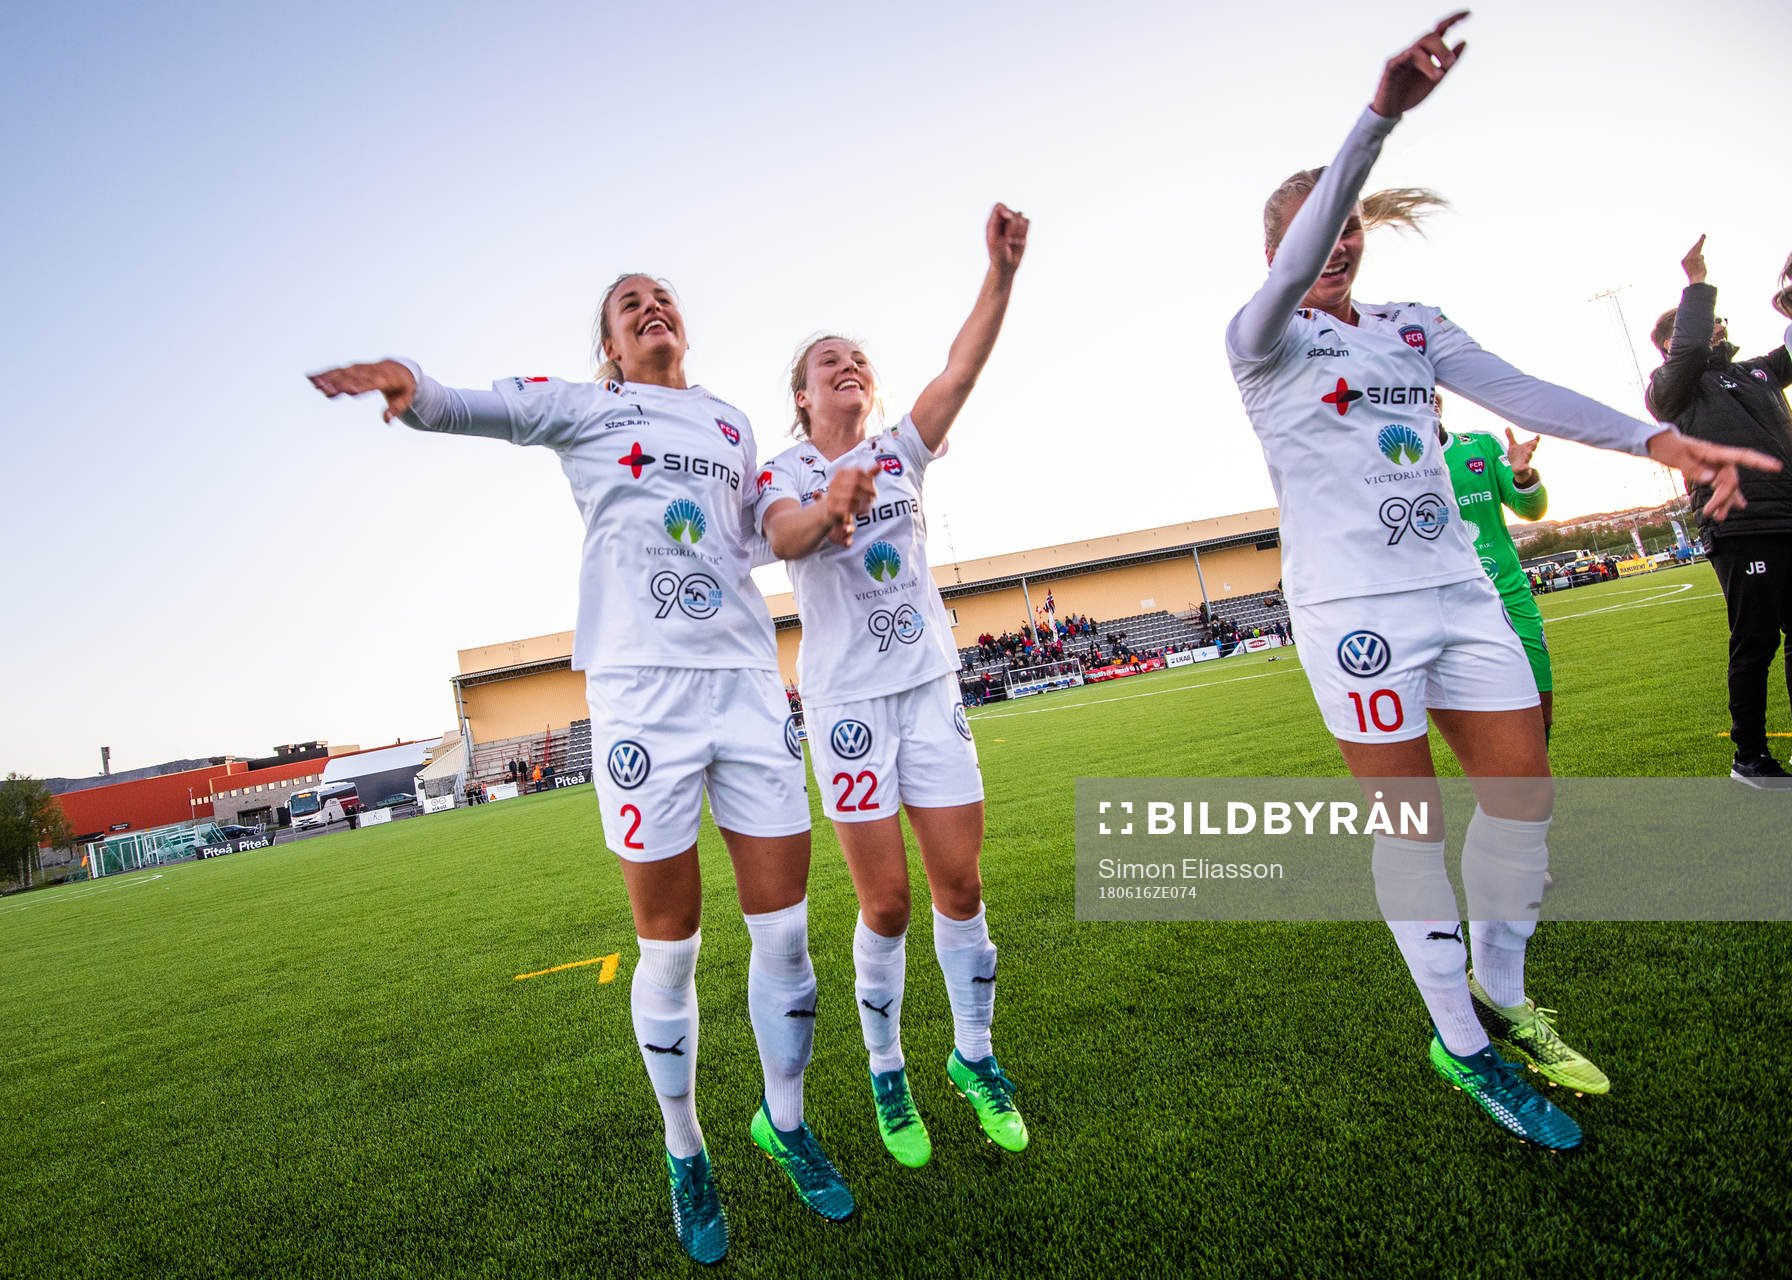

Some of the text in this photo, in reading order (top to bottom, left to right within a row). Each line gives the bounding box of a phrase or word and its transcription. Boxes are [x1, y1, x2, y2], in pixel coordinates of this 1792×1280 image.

[1404, 332, 1425, 343] FCR
[1306, 347, 1349, 359] stadium
[604, 419, 651, 431] stadium
[1468, 460, 1484, 469] FCR
[1364, 472, 1423, 485] VICTORIA
[645, 546, 698, 558] VICTORIA
[1745, 560, 1767, 575] JB
[855, 585, 899, 602] VICTORIA
[1347, 688, 1405, 733] 10
[554, 771, 586, 789] Piteå
[832, 770, 880, 813] 22
[619, 803, 645, 850] 2
[203, 836, 270, 859] Piteå Piteå
